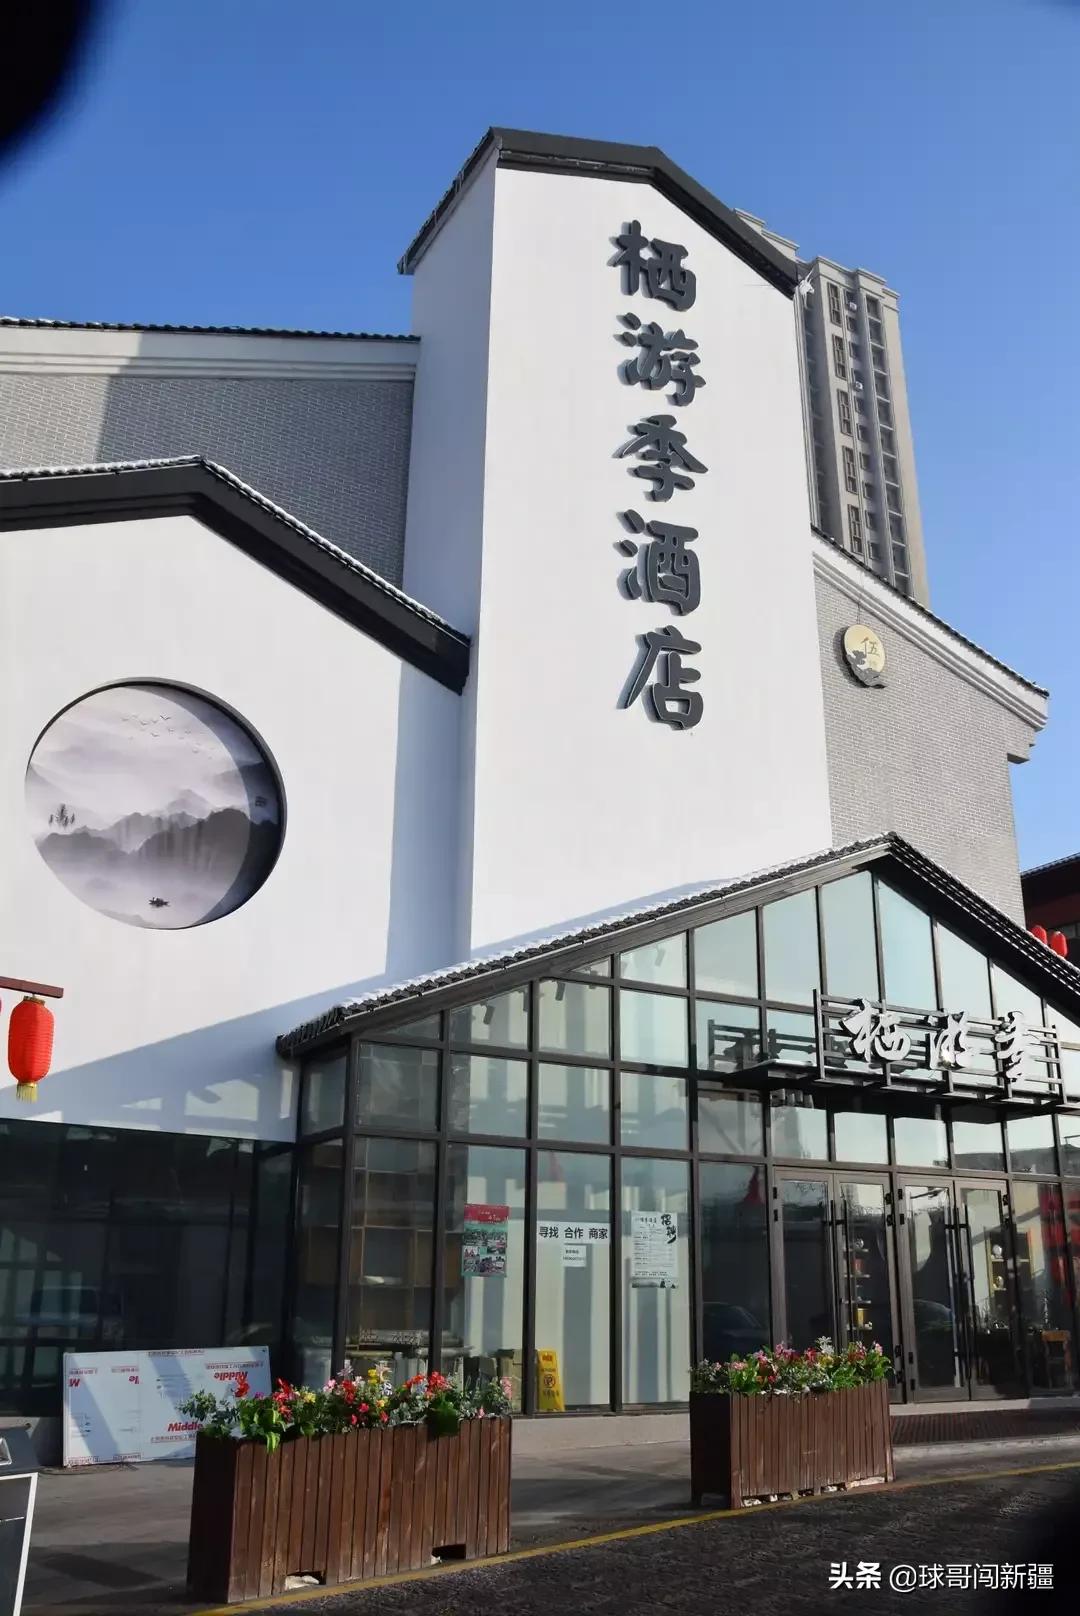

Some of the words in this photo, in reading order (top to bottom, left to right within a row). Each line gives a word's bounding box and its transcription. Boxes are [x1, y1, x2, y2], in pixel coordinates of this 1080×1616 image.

[609, 219, 708, 731] 栖游季酒店
[538, 1226, 559, 1239] 寻找
[563, 1226, 584, 1239] 合作
[588, 1227, 608, 1240] 商家
[167, 1422, 203, 1432] Middle
